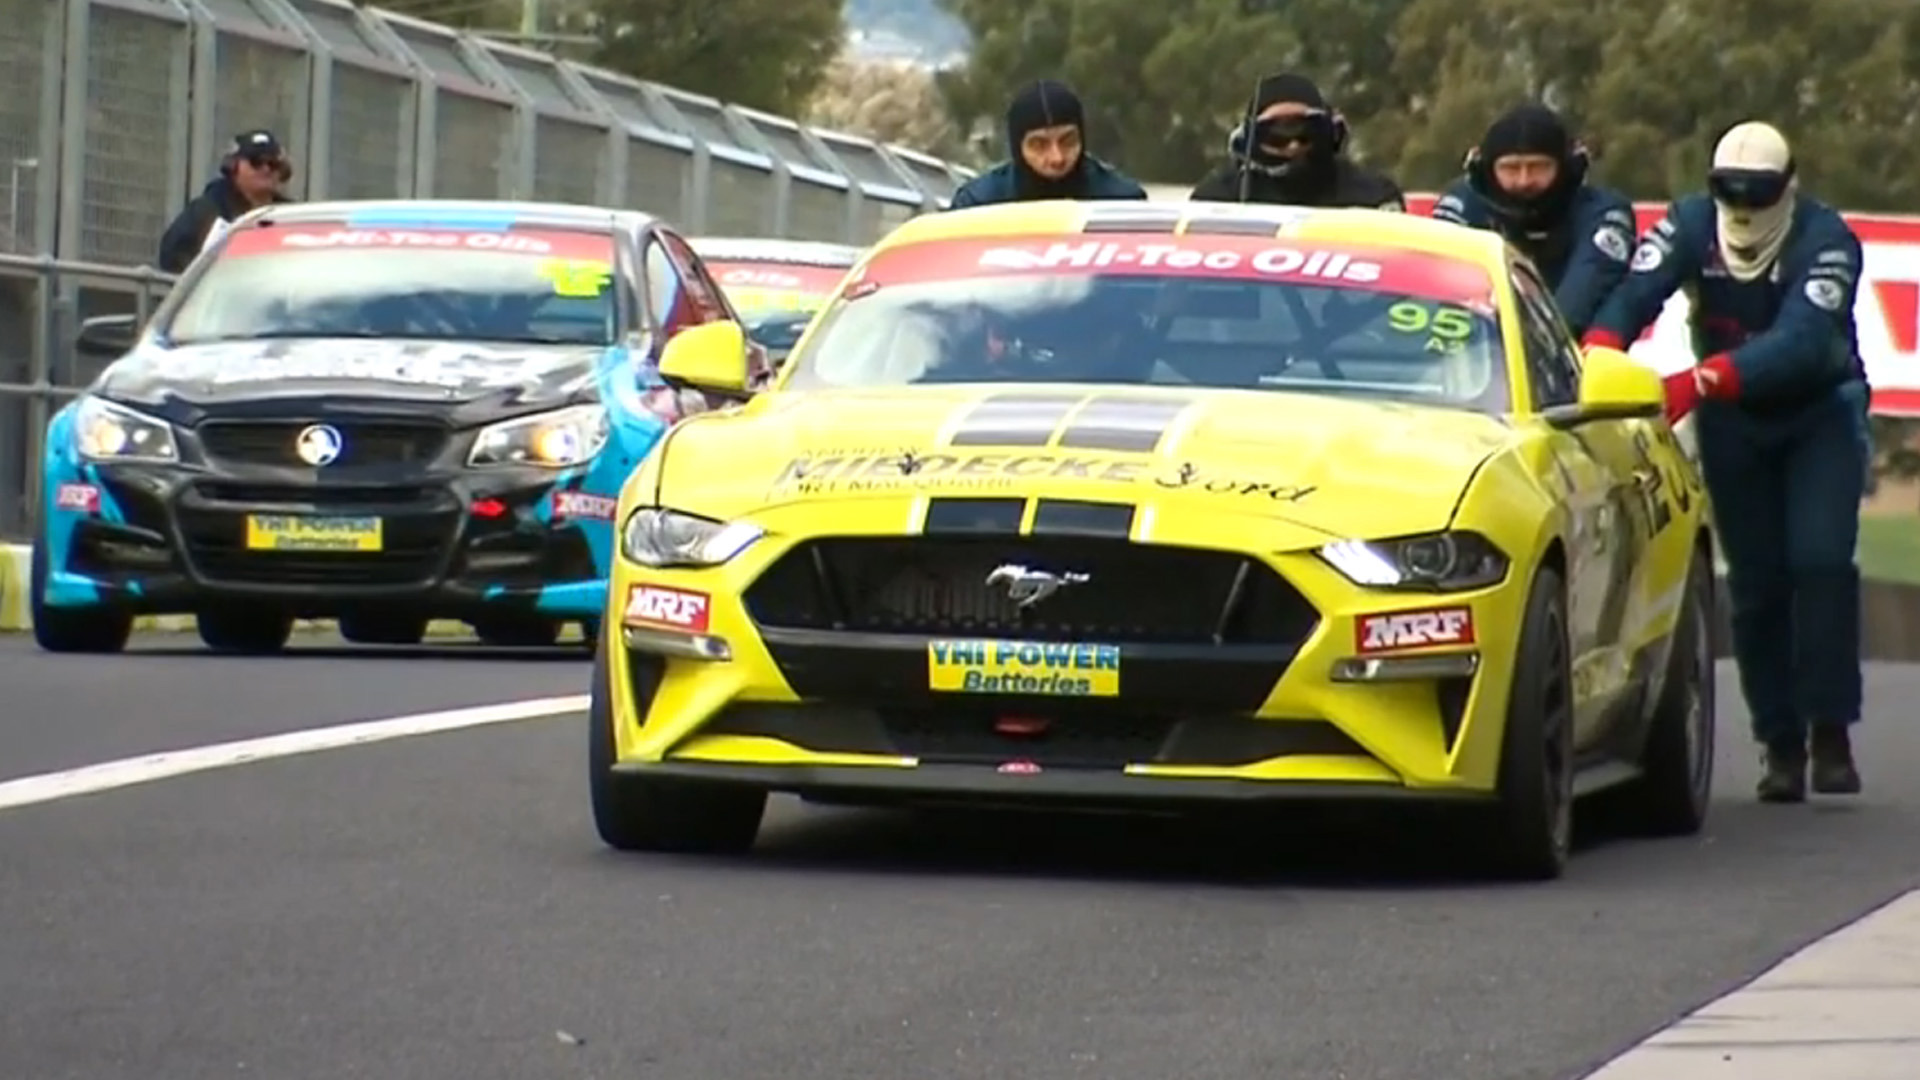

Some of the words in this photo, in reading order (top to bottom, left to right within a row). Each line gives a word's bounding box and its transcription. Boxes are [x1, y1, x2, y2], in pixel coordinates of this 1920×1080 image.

[1040, 242, 1239, 269] Hi-Tec
[1252, 248, 1383, 282] Oils
[1388, 303, 1471, 337] 95
[775, 454, 1149, 485] MIEDECKE
[625, 586, 706, 624] MRF
[1363, 609, 1469, 649] MRF
[933, 640, 985, 666] YHI
[995, 641, 1117, 670] POWER
[963, 669, 1090, 695] Batteries
